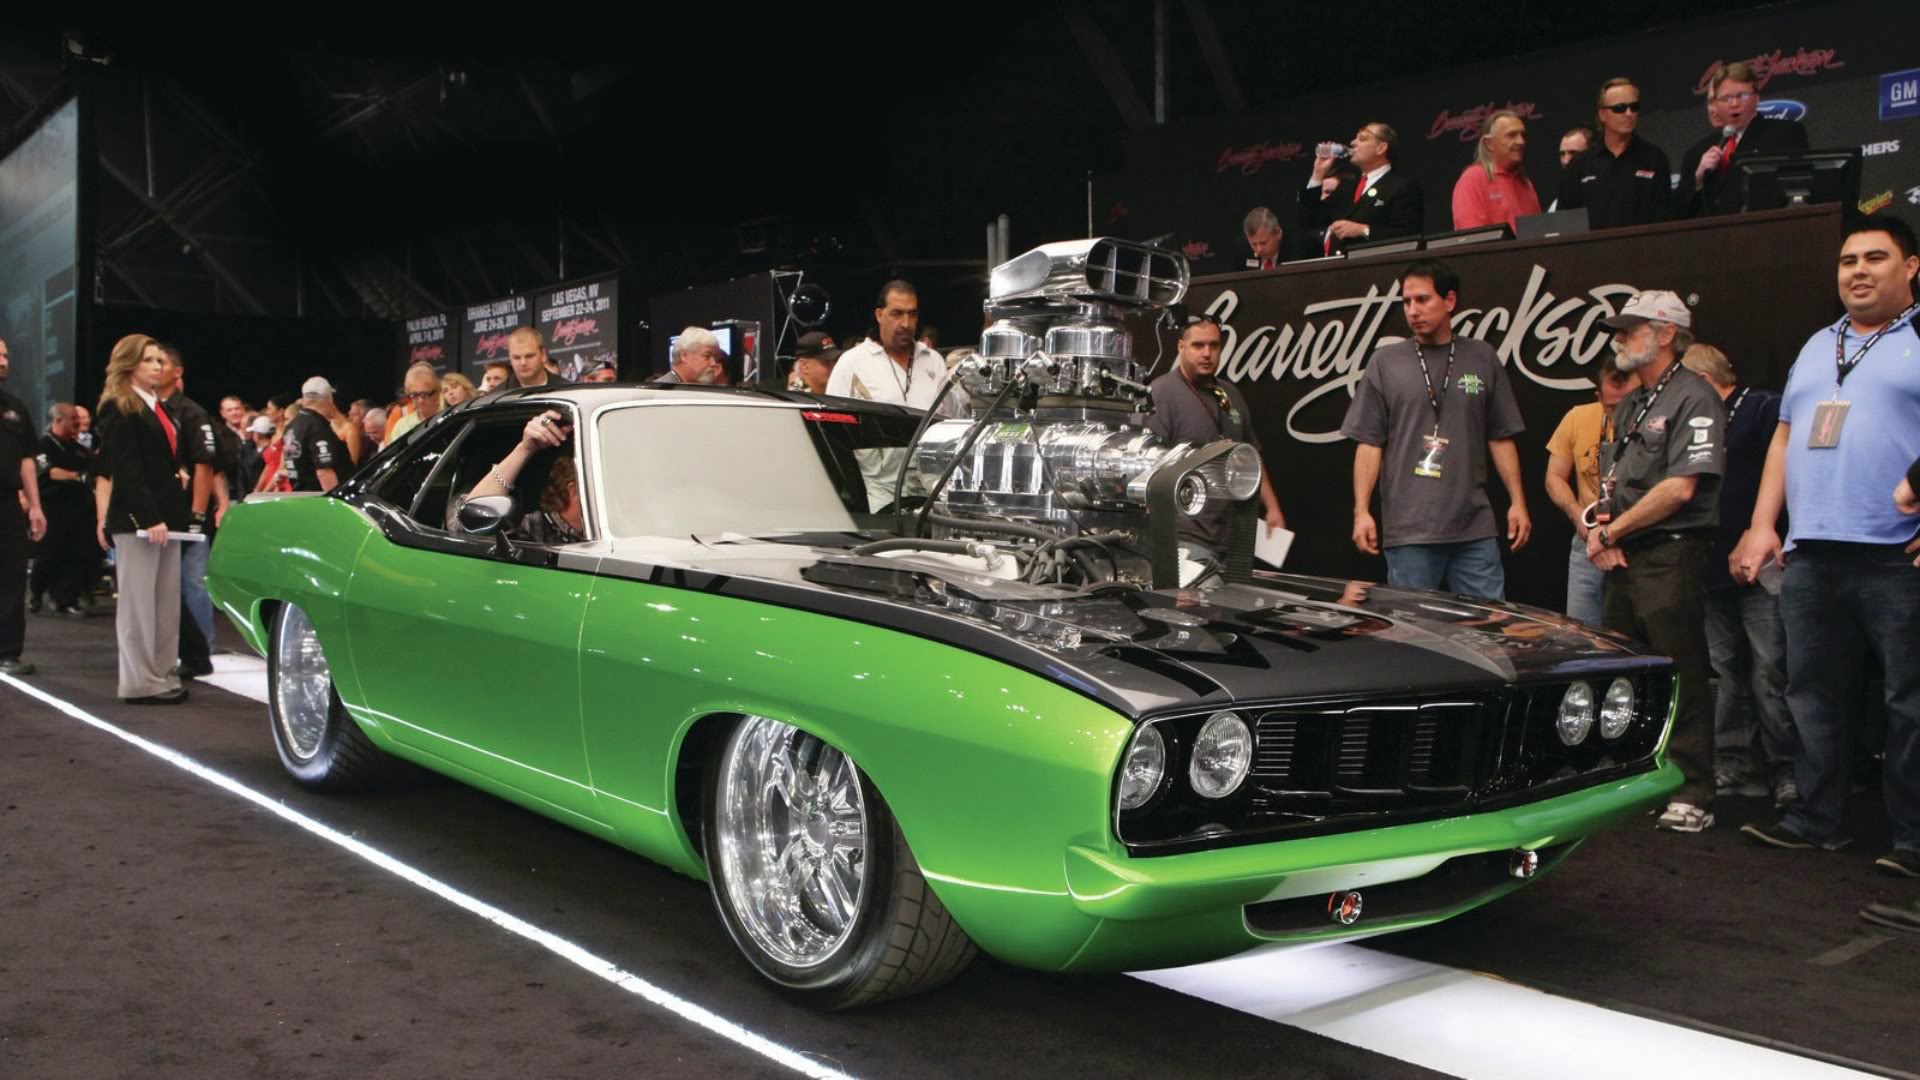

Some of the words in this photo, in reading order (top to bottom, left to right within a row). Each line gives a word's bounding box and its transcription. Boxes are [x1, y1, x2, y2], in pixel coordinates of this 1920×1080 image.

[1890, 79, 1918, 100] GM
[552, 292, 565, 307] LAS
[588, 283, 600, 298] NV
[541, 304, 575, 323] SEPTEMBER
